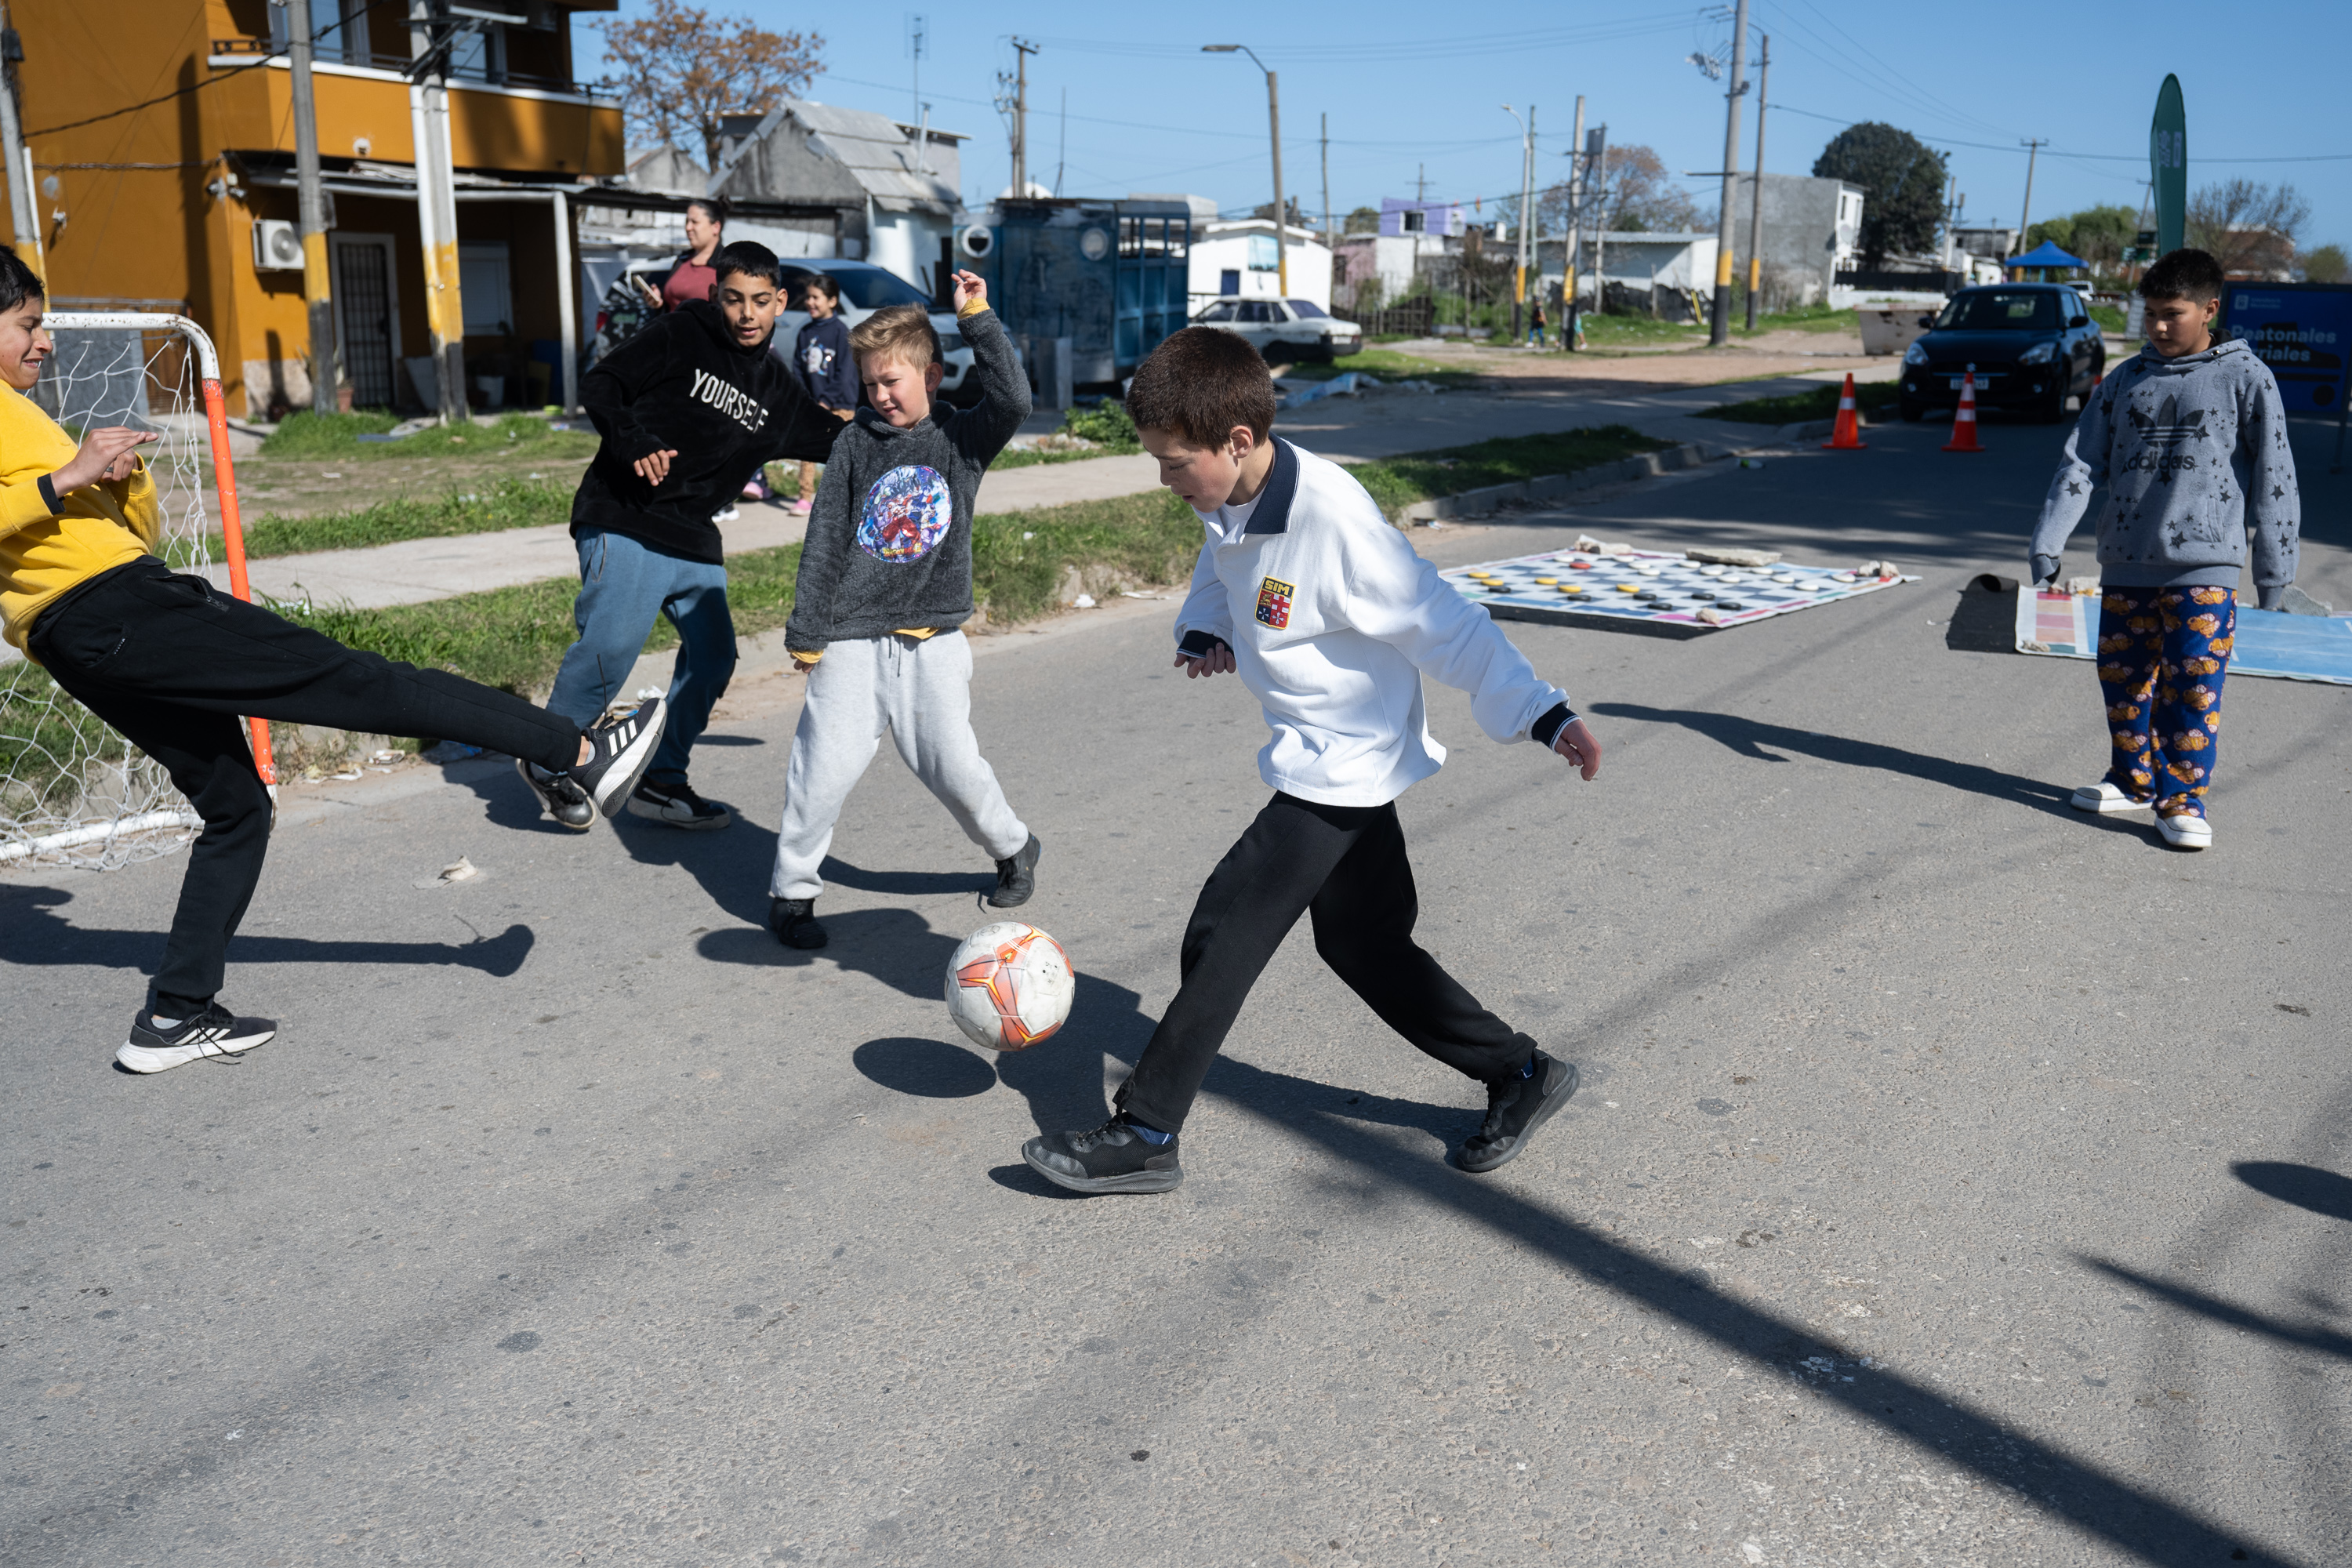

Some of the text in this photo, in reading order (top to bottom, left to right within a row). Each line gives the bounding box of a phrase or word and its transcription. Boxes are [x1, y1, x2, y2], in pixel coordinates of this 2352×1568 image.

[2231, 325, 2337, 344] Peatonales
[689, 368, 768, 434] YOURSELF
[2128, 451, 2195, 470] adidas
[1265, 580, 1290, 595] SIM
